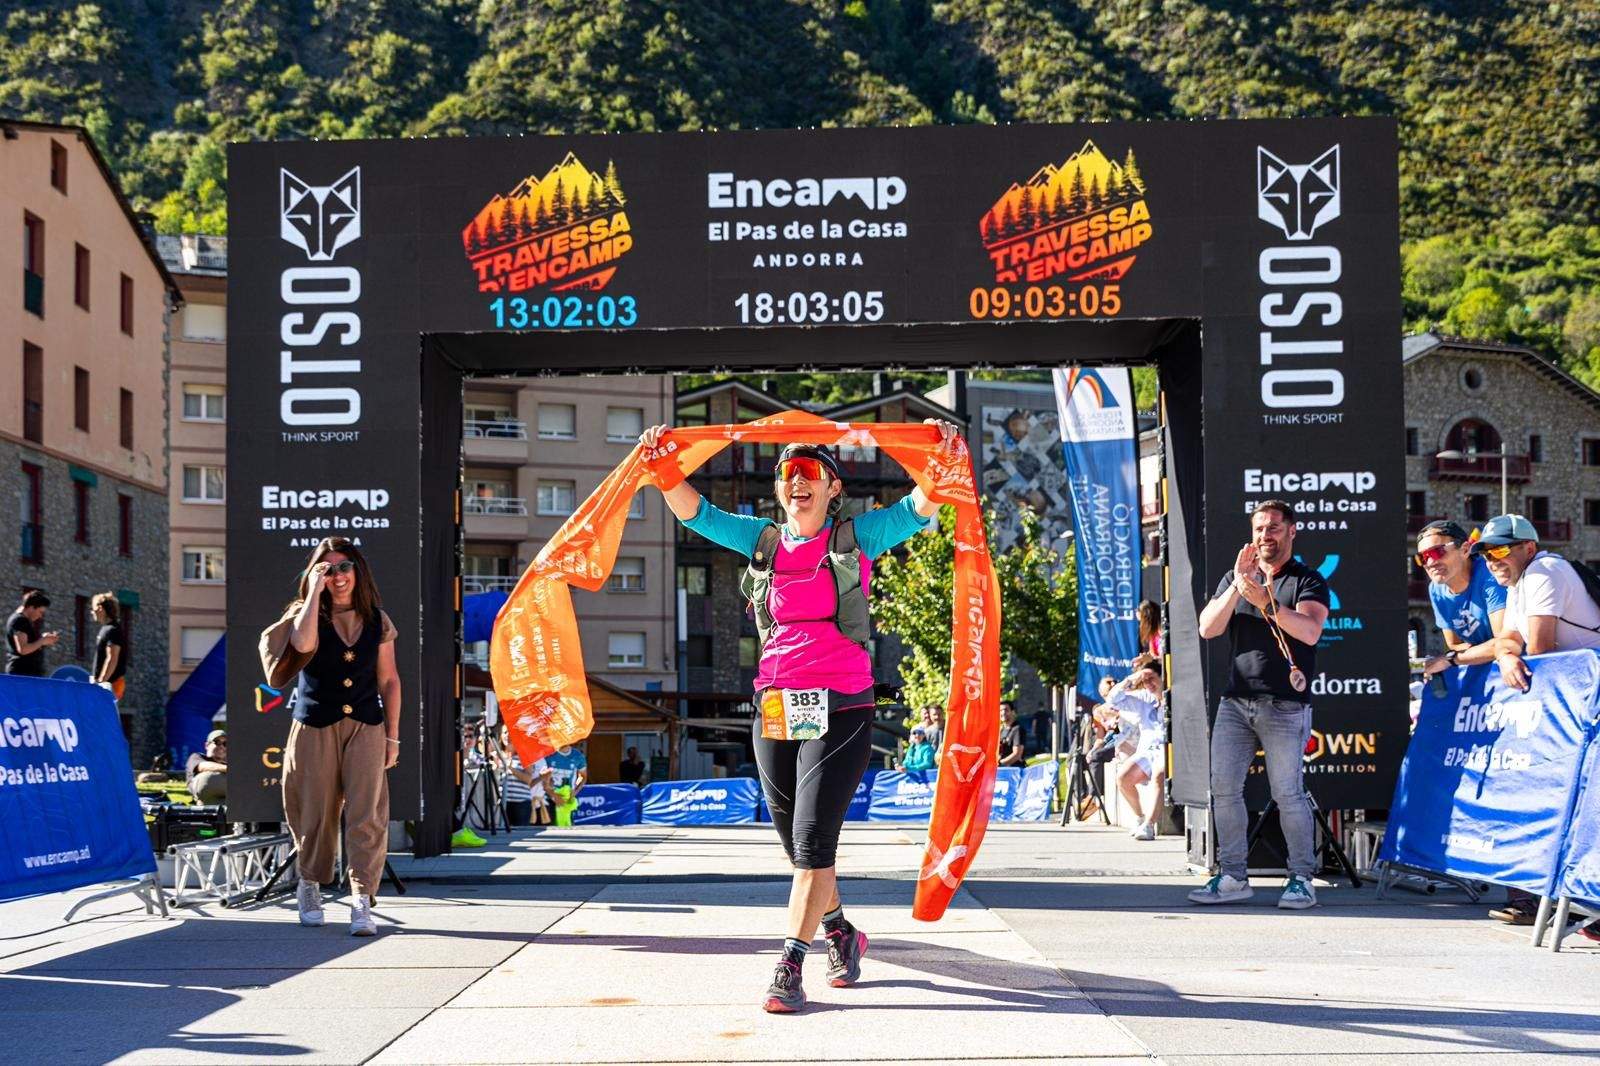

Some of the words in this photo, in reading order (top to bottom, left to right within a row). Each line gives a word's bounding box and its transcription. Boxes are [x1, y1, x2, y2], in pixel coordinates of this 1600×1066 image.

[708, 172, 907, 210] Encamp
[709, 222, 729, 241] El
[736, 221, 777, 241] Pas
[783, 220, 815, 240] de
[821, 219, 842, 239] la
[848, 219, 907, 239] Casa
[990, 200, 1150, 270] TRAVESSA
[472, 211, 631, 281] TRAVESSA
[753, 252, 864, 268] ANDORRA
[489, 296, 638, 328] 13:02:03
[735, 290, 884, 323] 18:03:05
[969, 285, 1121, 319] 09:03:05
[1259, 246, 1345, 408] OTSO
[280, 266, 361, 426] OTSO
[1263, 414, 1300, 425] THINK
[1303, 413, 1344, 424] SPORT
[281, 431, 318, 442] THINK
[320, 430, 359, 441] SPORT
[1244, 469, 1376, 494] Encamp
[262, 486, 389, 511] Encamp
[1294, 500, 1315, 512] de
[1320, 499, 1334, 512] la
[1337, 499, 1376, 512] Casa
[262, 517, 276, 529] El
[280, 517, 306, 530] Pas
[310, 516, 331, 529] de
[334, 516, 348, 529] la
[351, 516, 389, 529] Casa
[1296, 521, 1348, 530] DORRA
[290, 537, 361, 547] ANDA
[962, 569, 988, 700] Encamp
[1322, 617, 1362, 630] ALIRA
[1311, 673, 1382, 695] dorra
[790, 691, 820, 707] 383
[25, 764, 43, 784] de
[44, 763, 58, 783] la
[58, 763, 89, 782] Casa
[24, 845, 91, 869] www.encamp.ad
